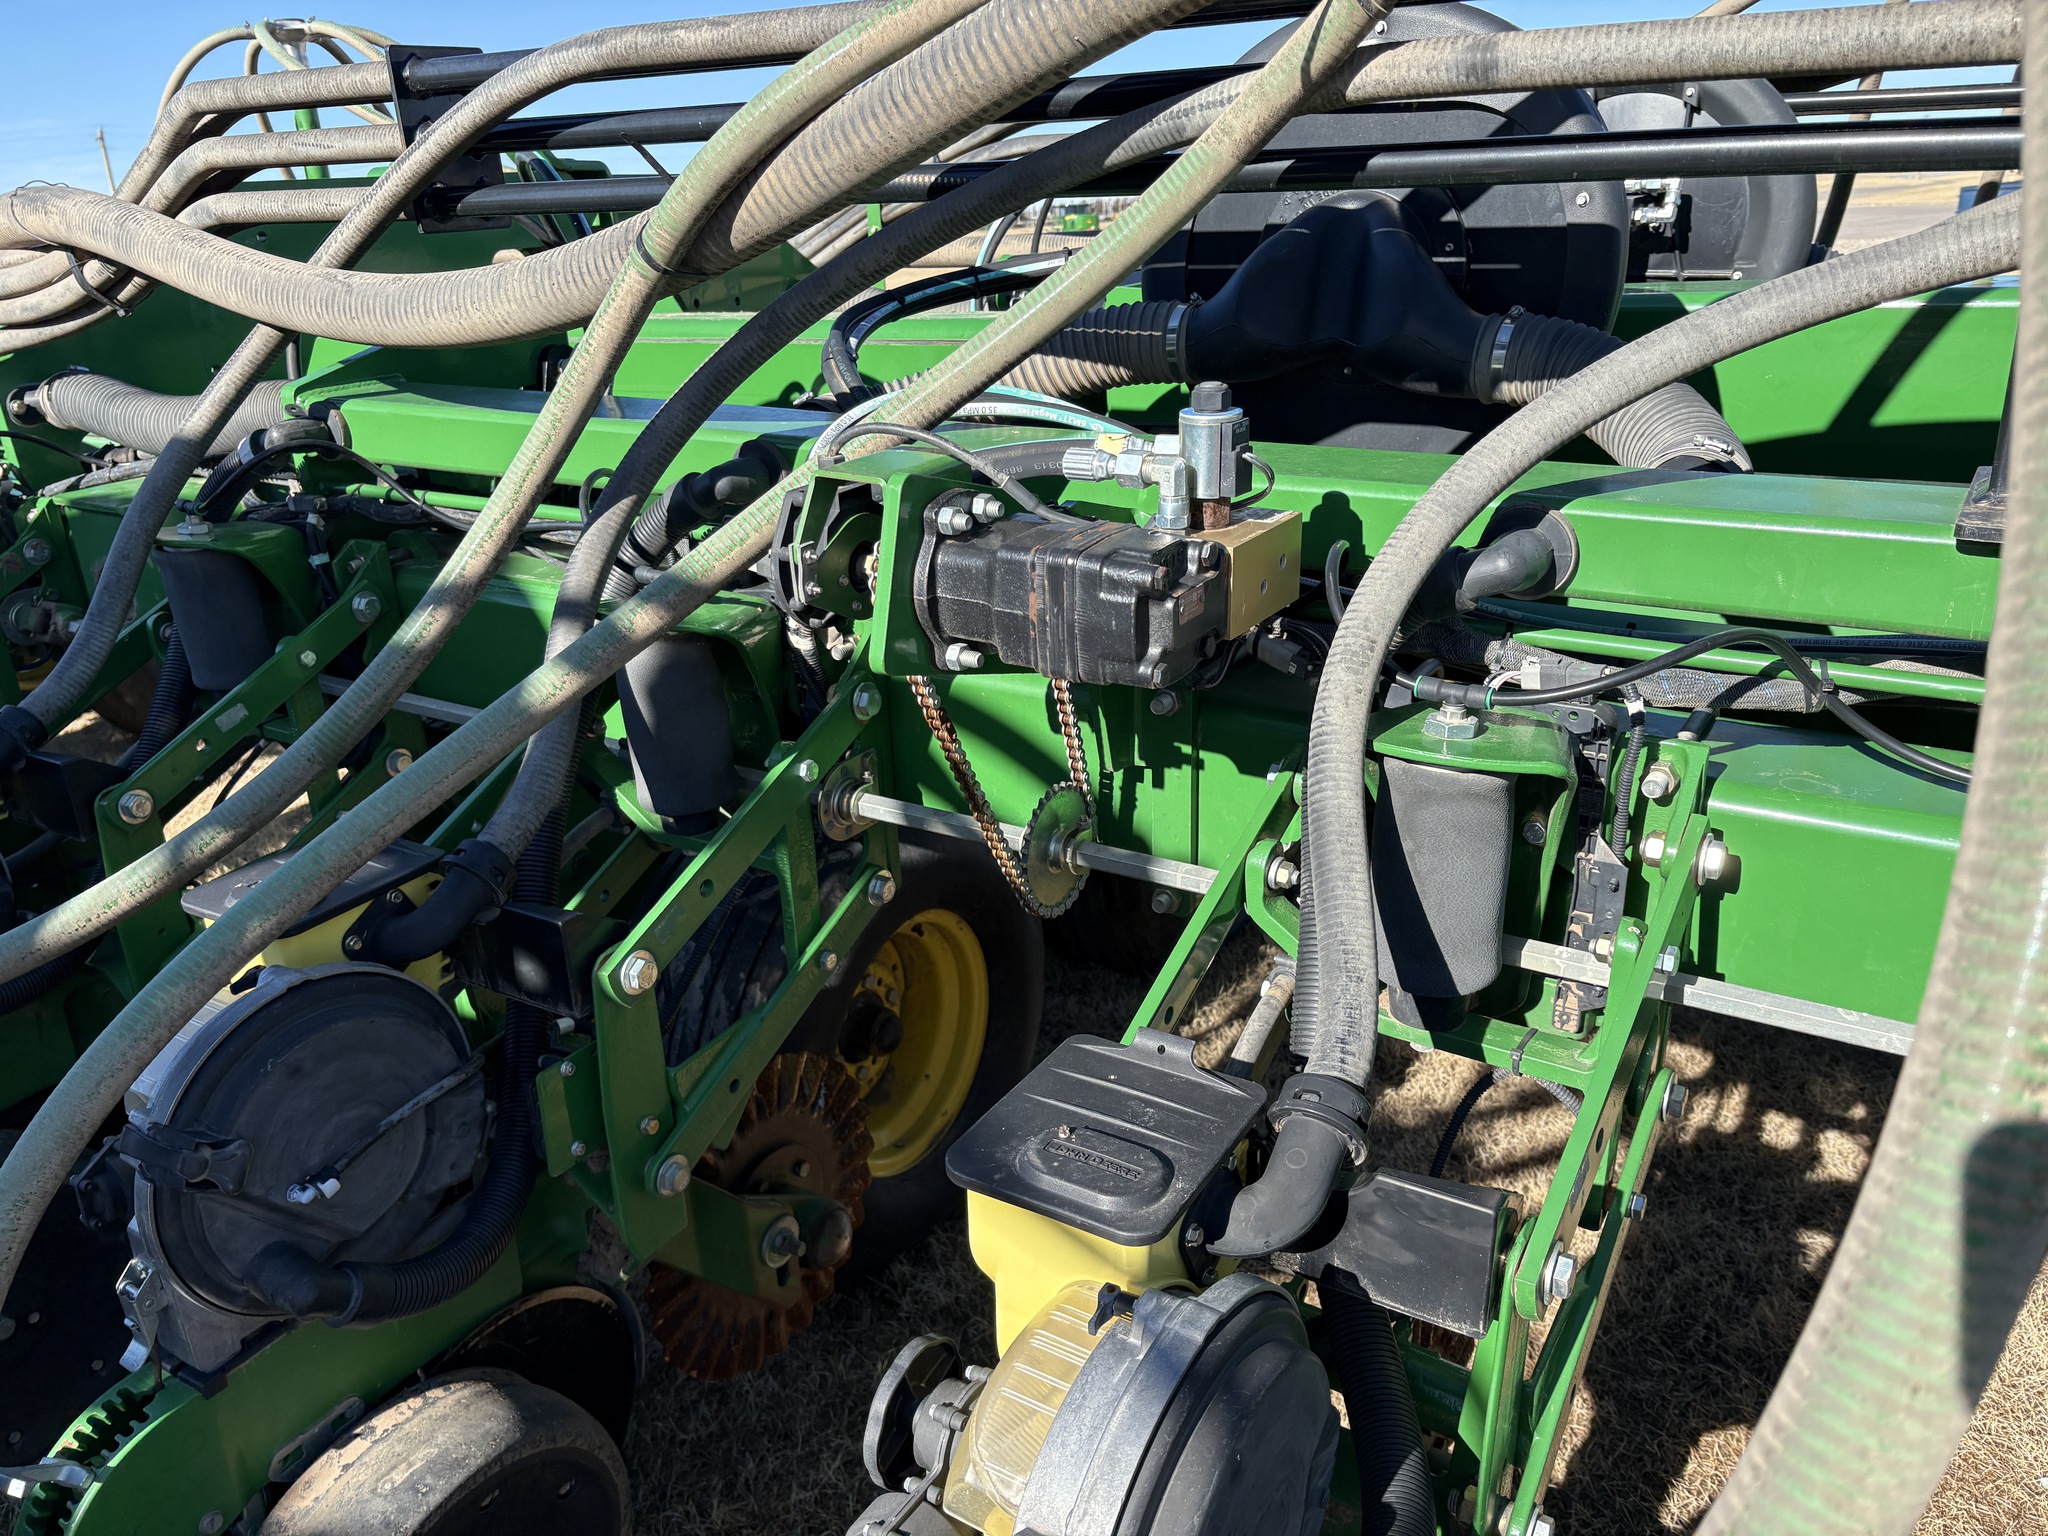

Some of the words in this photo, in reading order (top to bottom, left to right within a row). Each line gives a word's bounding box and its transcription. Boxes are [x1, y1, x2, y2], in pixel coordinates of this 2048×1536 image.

[962, 406, 979, 414] MPa
[1017, 407, 1057, 419] MegaFlex
[1046, 1143, 1090, 1162] JOHN
[1088, 1155, 1141, 1181] DEERE
